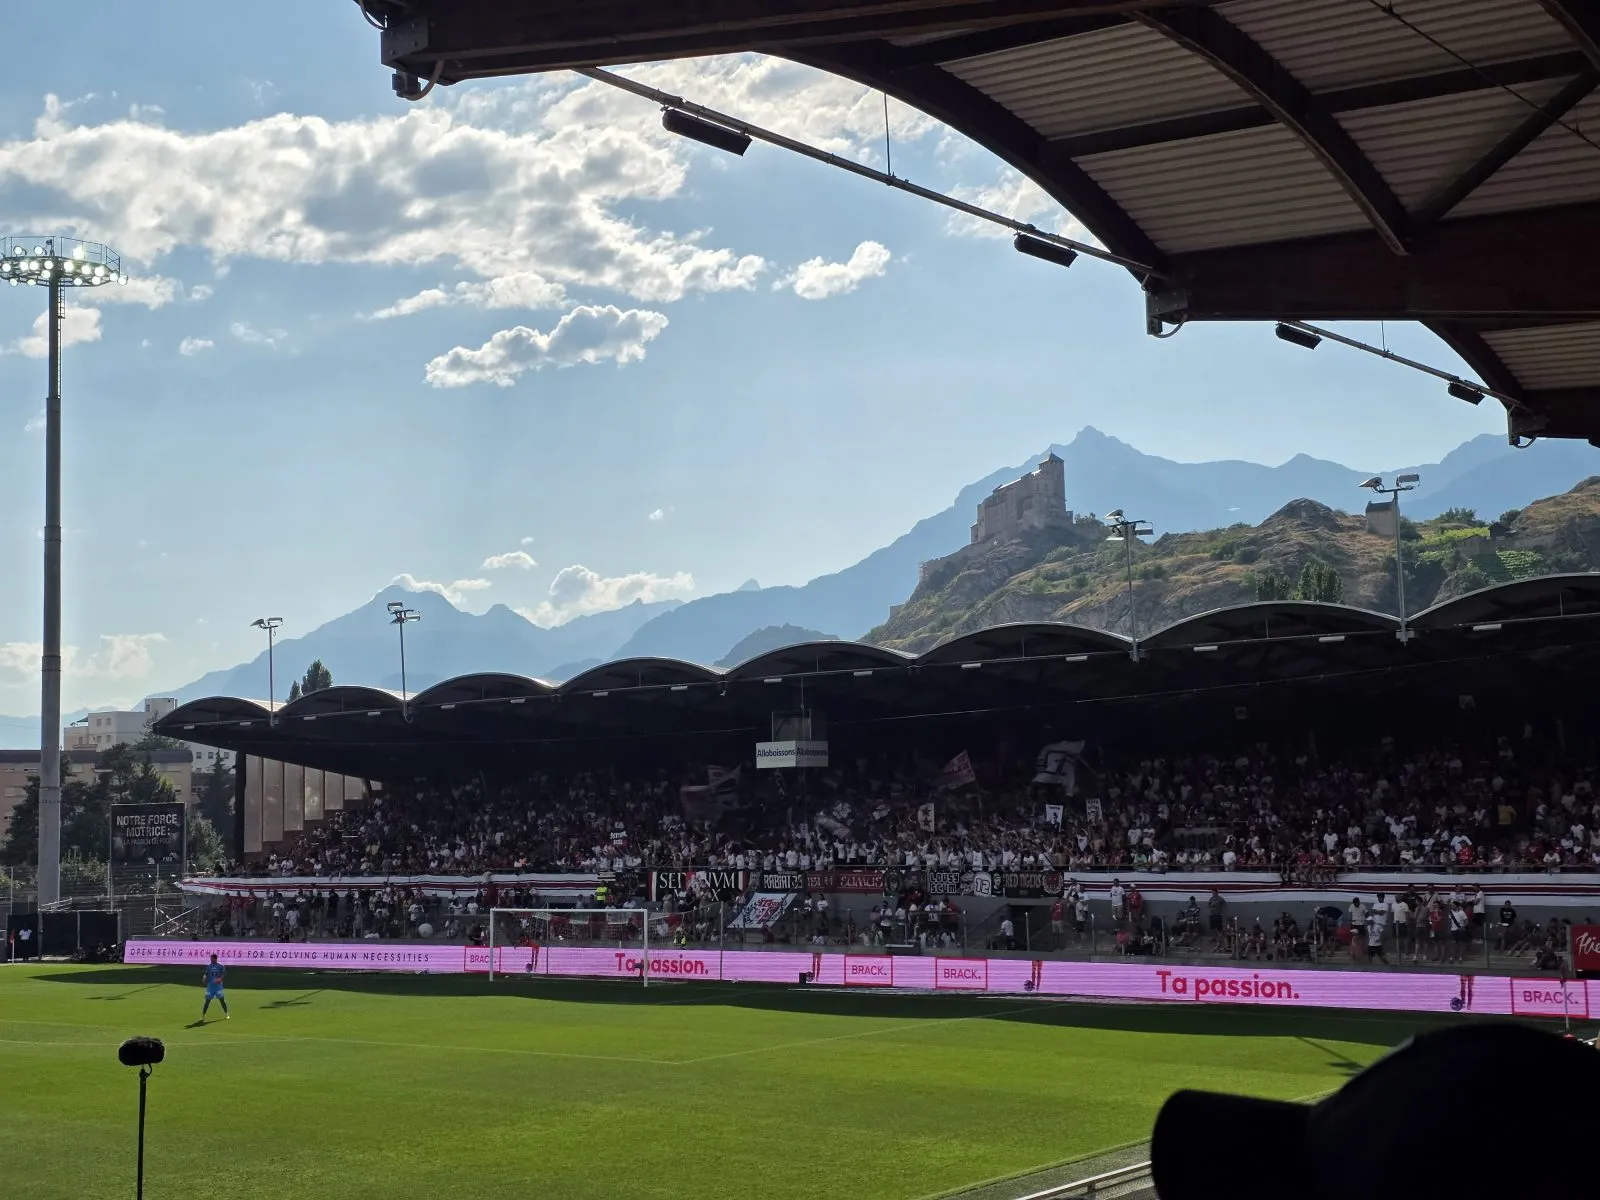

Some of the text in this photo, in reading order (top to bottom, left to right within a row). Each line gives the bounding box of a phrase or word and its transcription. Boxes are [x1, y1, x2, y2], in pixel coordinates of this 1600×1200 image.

[116, 814, 178, 826] NOTRE FORCE
[930, 872, 960, 883] LOUSY
[1004, 873, 1042, 888] RED TIGERS
[930, 883, 958, 894] SCUM
[130, 948, 430, 962] OPEN BEING ARCHITECTS FOR EVOLVING HUMAN NECESSITIES
[470, 954, 497, 964] BRAC.
[615, 953, 636, 972] Ta
[851, 964, 887, 976] BRACK.
[943, 968, 982, 980] BRACK.
[1156, 970, 1300, 1000] Ta passion.
[1523, 990, 1579, 1005] BRACK.
